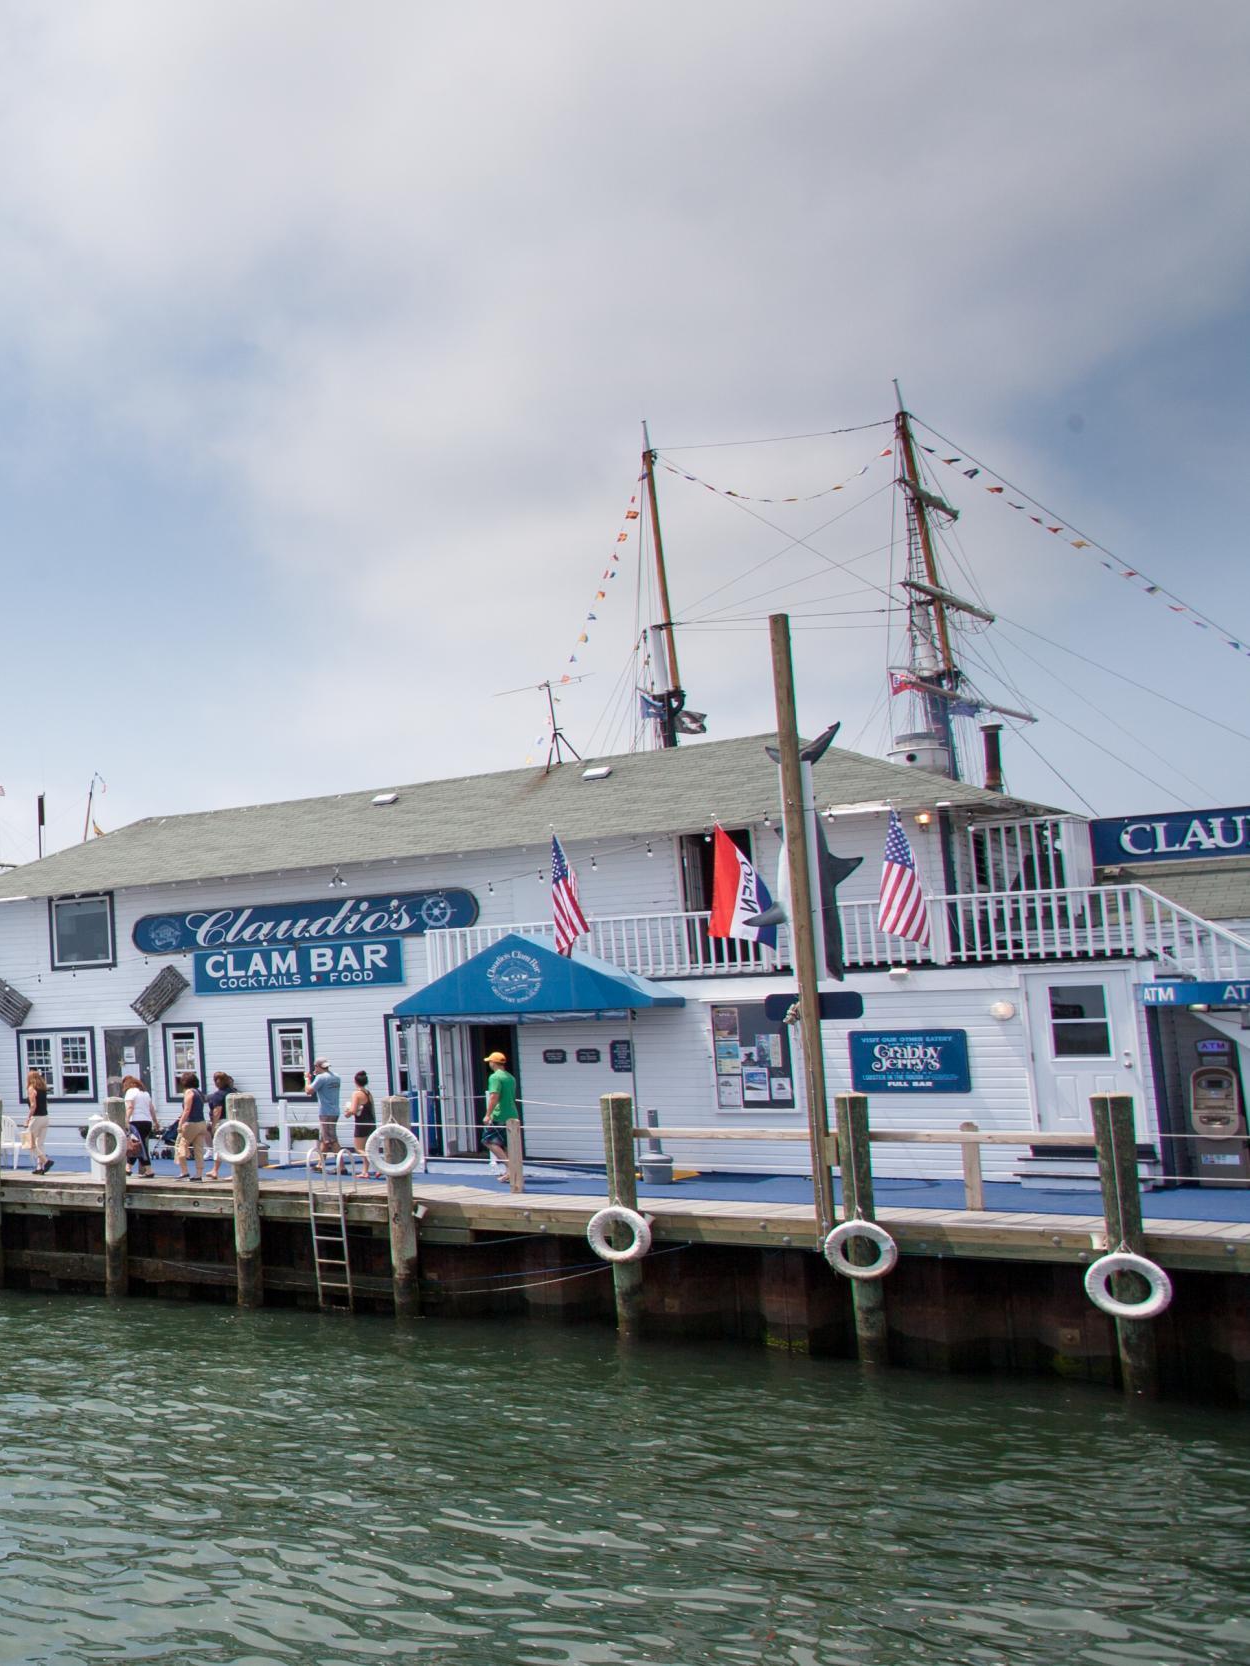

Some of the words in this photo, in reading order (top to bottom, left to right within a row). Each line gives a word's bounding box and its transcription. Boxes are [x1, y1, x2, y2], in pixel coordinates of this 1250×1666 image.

[1119, 816, 1250, 855] CLAU
[186, 899, 417, 946] Claudio's
[205, 950, 297, 978] CLAM
[310, 944, 388, 972] BAR
[219, 974, 302, 989] COCKTAILS
[330, 970, 374, 984] FOOD
[1143, 987, 1174, 1002] ATM
[873, 1044, 943, 1059] Crabby
[871, 1057, 941, 1072] Jerry's
